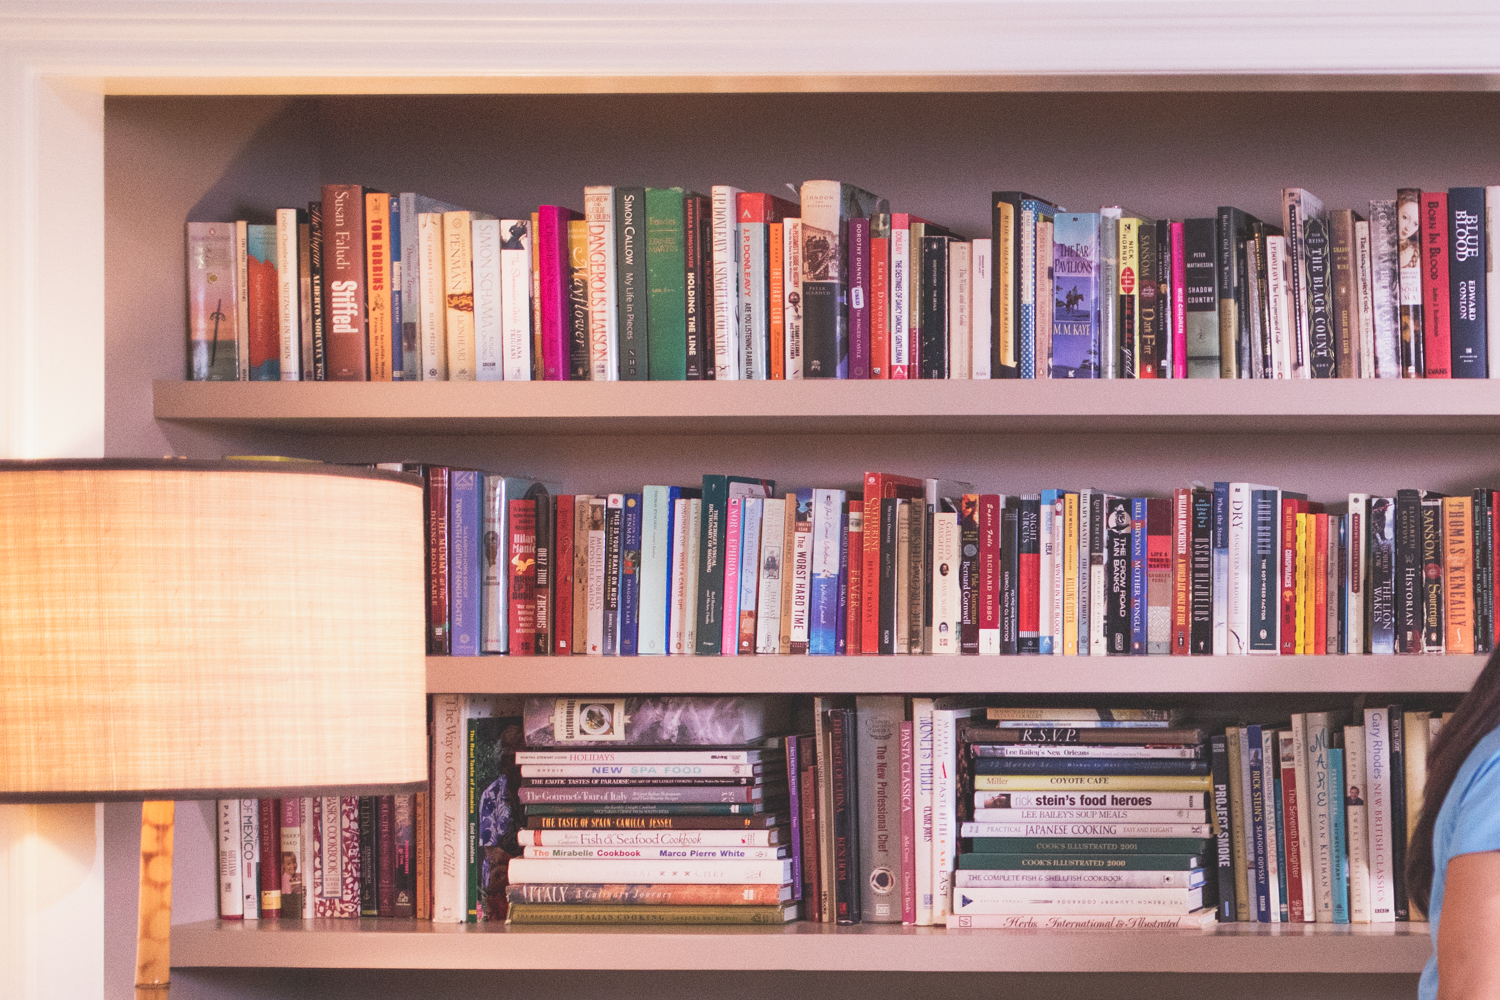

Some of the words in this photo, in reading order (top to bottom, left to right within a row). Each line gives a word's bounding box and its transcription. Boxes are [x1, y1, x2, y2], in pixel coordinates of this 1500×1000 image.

[334, 191, 348, 226] Susan
[624, 195, 634, 225] SIMON
[371, 218, 382, 240] TOM
[1455, 210, 1468, 261] BLOOD
[1466, 215, 1478, 256] BLUE
[336, 231, 349, 270] Faludi
[625, 227, 635, 265] CALLOW
[1311, 248, 1323, 272] THE
[372, 246, 384, 291] ROBBINS
[625, 272, 634, 286] My
[331, 281, 358, 333] Stiffed
[626, 288, 634, 302] Life
[627, 304, 634, 312] in
[1313, 277, 1325, 313] BLACK
[1460, 281, 1468, 319] CONLON
[1468, 280, 1476, 320] EDWARD
[627, 314, 635, 339] Pieces
[1314, 317, 1327, 356] COUNT
[729, 508, 738, 534] NORA
[1450, 502, 1464, 554] THOMAS
[797, 536, 807, 548] The
[728, 539, 738, 576] EPHRON
[796, 551, 807, 580] WORST
[612, 576, 617, 585] ON
[795, 584, 805, 606] HARD
[1383, 580, 1391, 603] THE
[1374, 587, 1382, 622] WAKES
[1449, 567, 1466, 627] KENEALLY
[794, 610, 804, 630] TIME
[1383, 606, 1391, 630] LION
[446, 700, 456, 723] The
[444, 724, 456, 750] Way
[445, 752, 455, 765] to
[877, 746, 887, 759] The
[445, 767, 455, 801] Cook
[631, 766, 656, 774] SPA
[664, 766, 701, 774] FOOD
[878, 763, 887, 779] New
[877, 782, 887, 831] Professional
[1015, 794, 1034, 806] rick
[1035, 794, 1075, 806] stein's
[1079, 794, 1106, 806] food
[1110, 794, 1152, 806] heroes
[1215, 784, 1226, 830] PROJECT
[444, 813, 455, 842] Julia
[720, 849, 745, 857] White
[878, 834, 888, 852] Chef
[1218, 832, 1230, 867] SMOKE
[443, 844, 455, 878] Child
